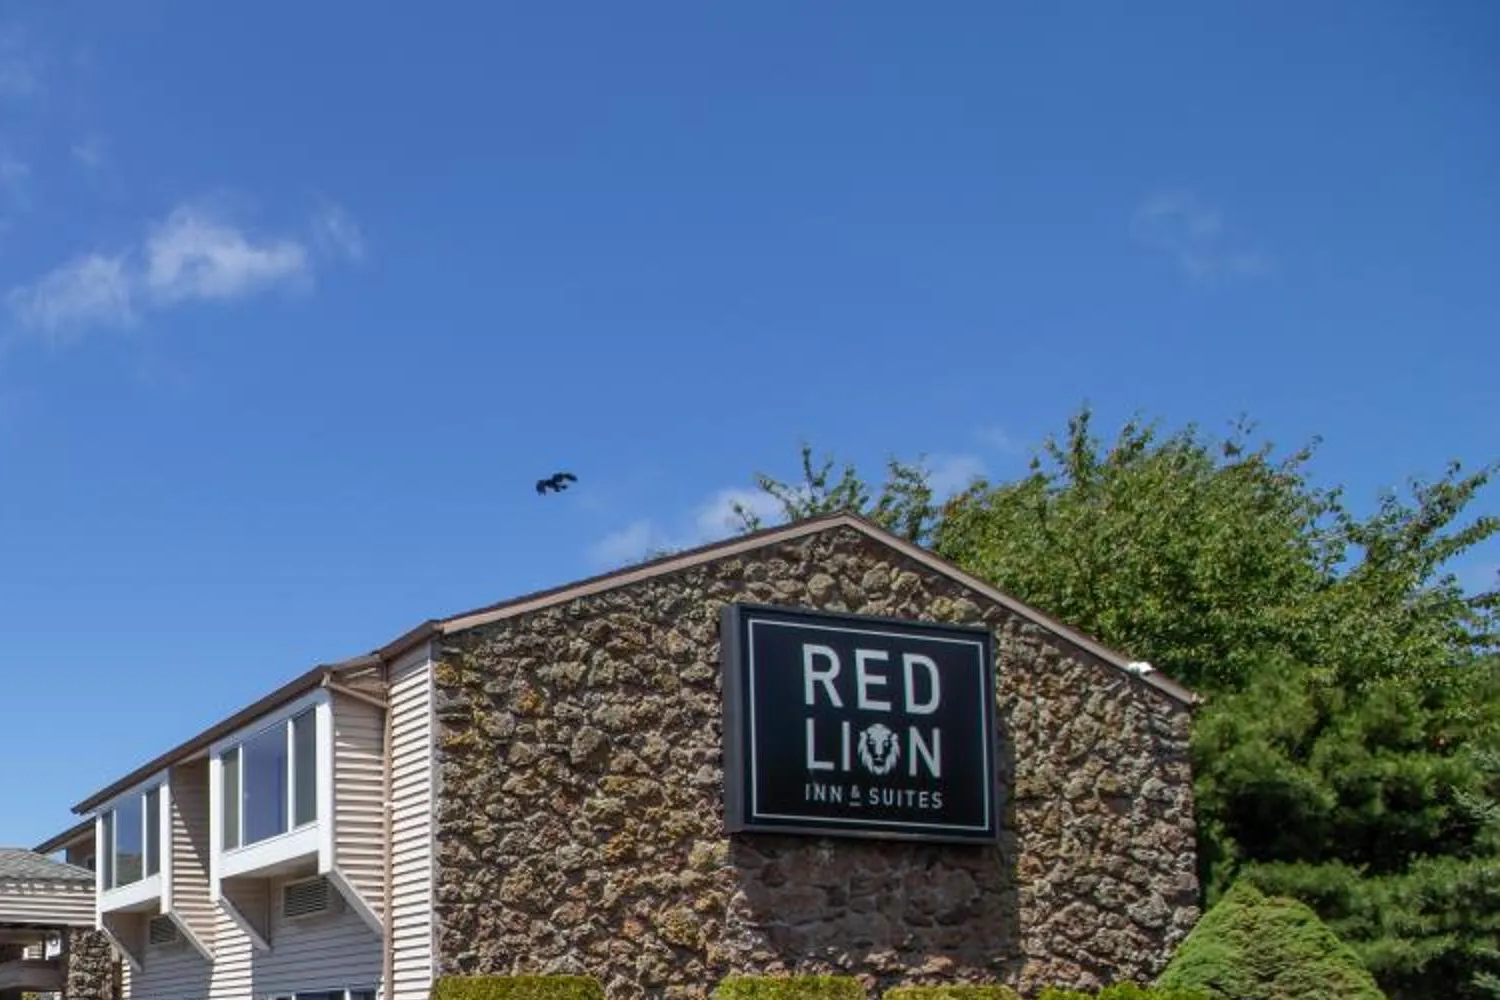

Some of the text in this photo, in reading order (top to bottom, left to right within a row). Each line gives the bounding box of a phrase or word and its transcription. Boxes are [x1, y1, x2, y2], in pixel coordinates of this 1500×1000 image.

[802, 642, 942, 716] RED
[805, 782, 943, 809] INN & SUITES
